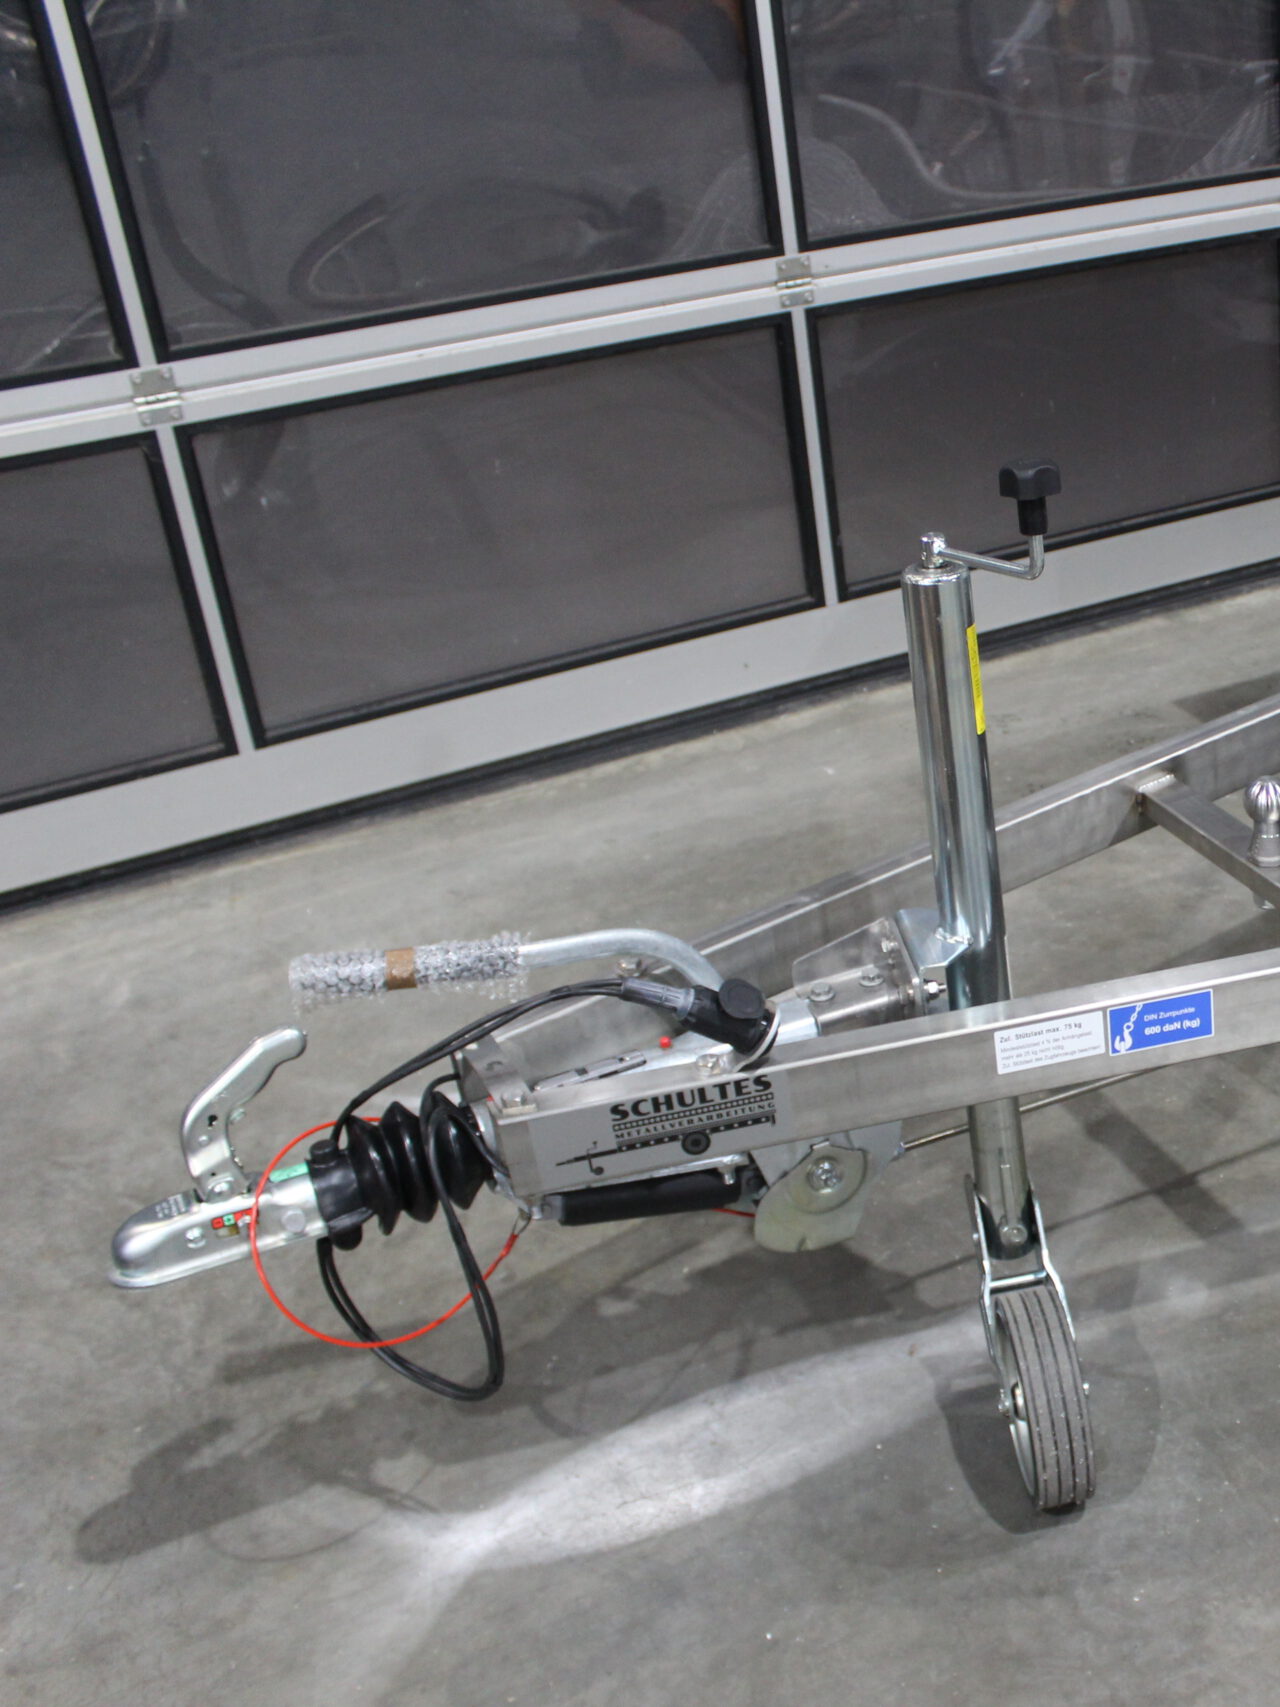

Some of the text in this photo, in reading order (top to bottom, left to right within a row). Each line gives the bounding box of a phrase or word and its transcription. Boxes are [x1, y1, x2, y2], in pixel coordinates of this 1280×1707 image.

[1144, 1013, 1157, 1022] DIN
[1144, 1017, 1200, 1035] 600 daN (kg)
[1045, 1025, 1061, 1034] max.
[1073, 1021, 1082, 1029] kg
[610, 1074, 772, 1122] SCHULTES
[615, 1103, 775, 1138] METALLVERARBEITUNG
